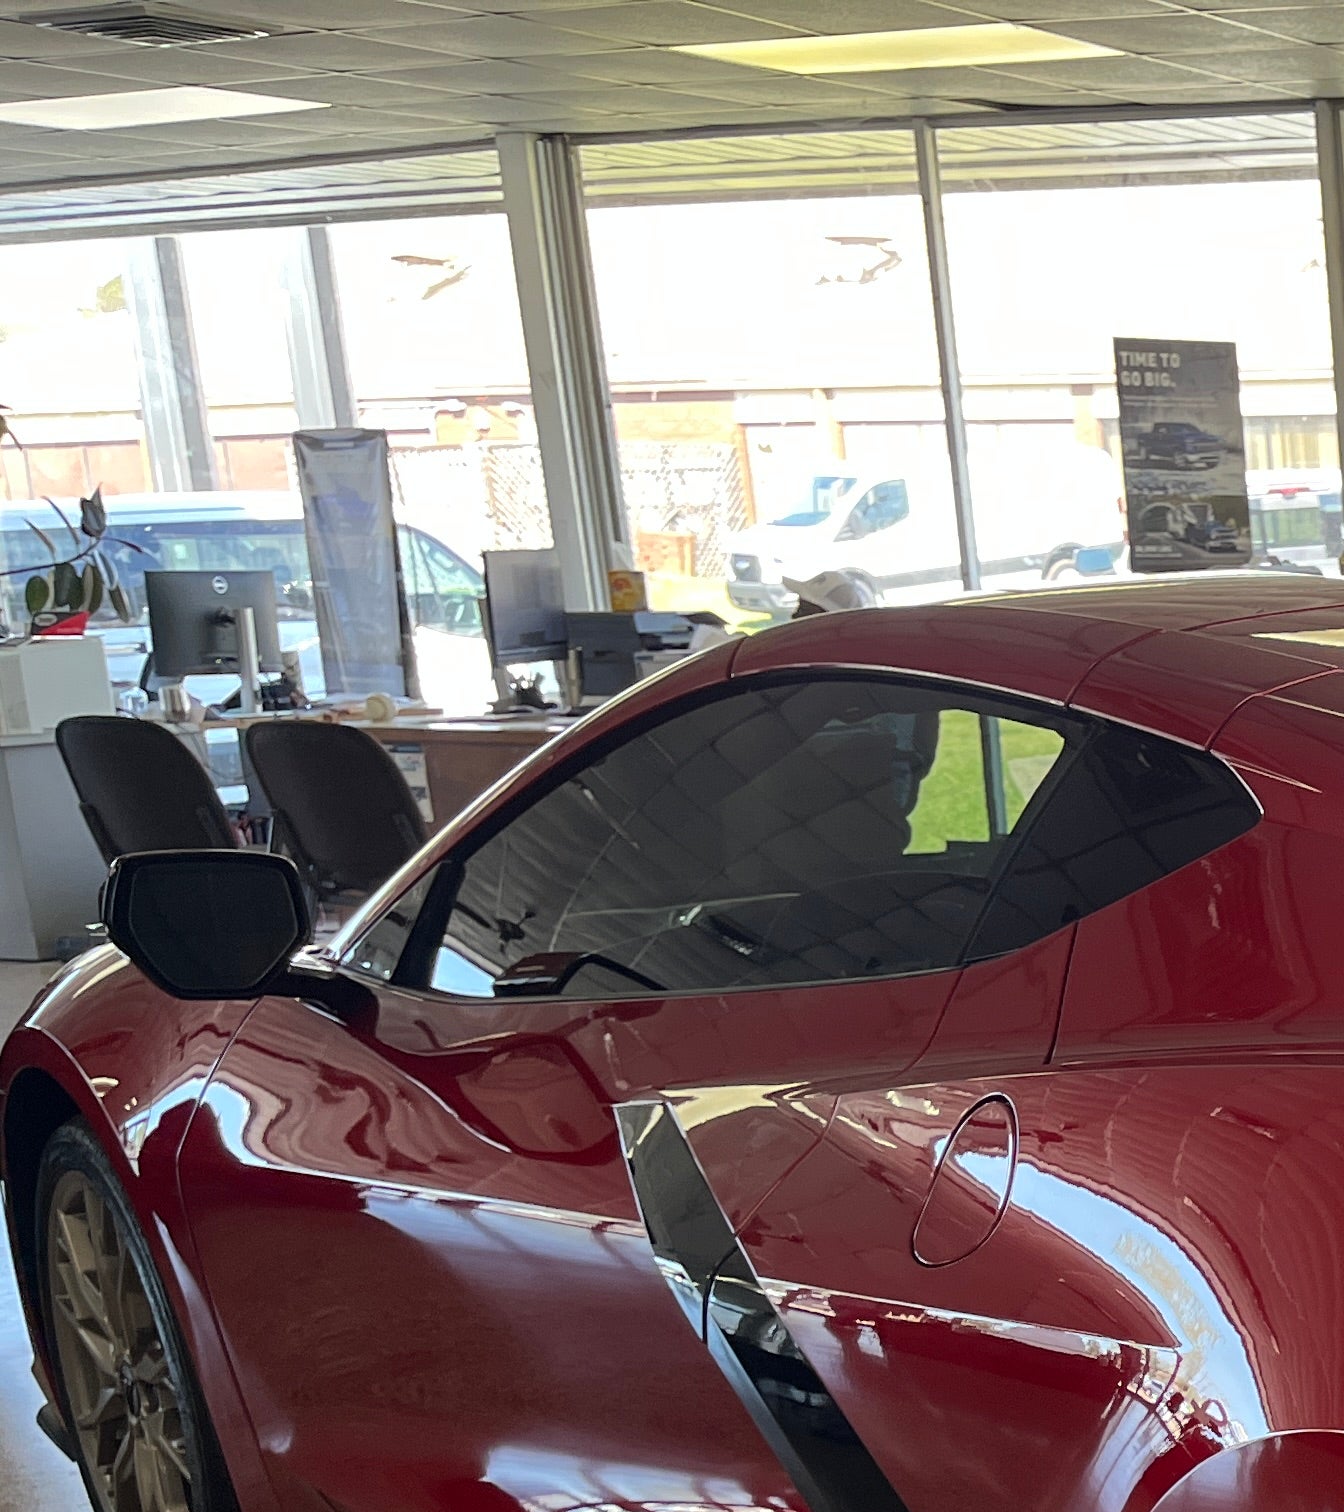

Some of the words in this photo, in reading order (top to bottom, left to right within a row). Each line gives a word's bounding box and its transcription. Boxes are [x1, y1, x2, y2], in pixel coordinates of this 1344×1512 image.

[1119, 351, 1157, 368] TIME
[1159, 352, 1181, 369] TO
[1120, 370, 1142, 387] GO
[1144, 371, 1177, 388] BIG.
